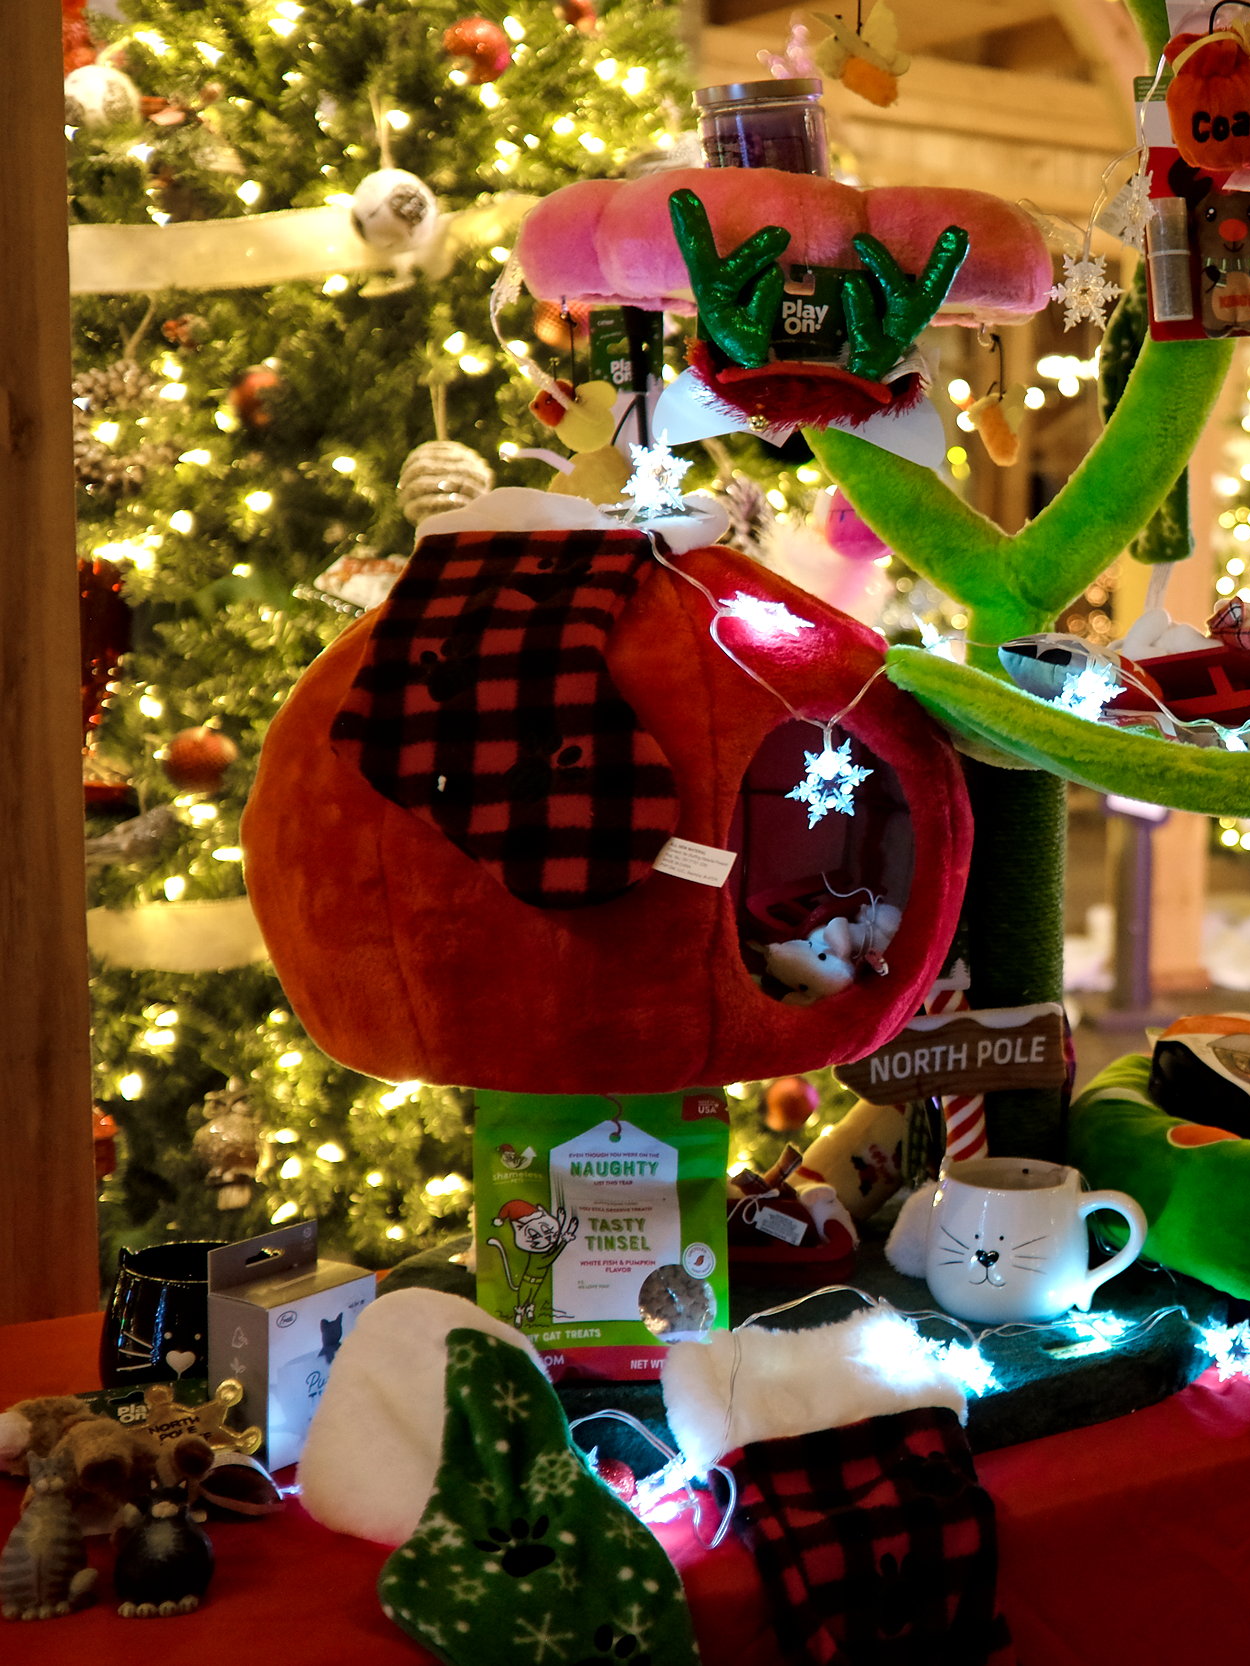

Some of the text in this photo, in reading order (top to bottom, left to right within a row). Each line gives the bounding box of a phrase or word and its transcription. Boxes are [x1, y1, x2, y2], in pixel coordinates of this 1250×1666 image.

[782, 299, 829, 324] Play
[870, 1036, 1046, 1085] NORTH POLE
[698, 1106, 717, 1114] USA
[570, 1160, 659, 1177] NAUGHTY
[588, 1217, 646, 1232] TASTY
[584, 1235, 651, 1252] TINSEL
[543, 1331, 561, 1342] CAT
[565, 1328, 601, 1339] TREATS
[630, 1359, 648, 1370] NET
[148, 1416, 200, 1435] NORTH
